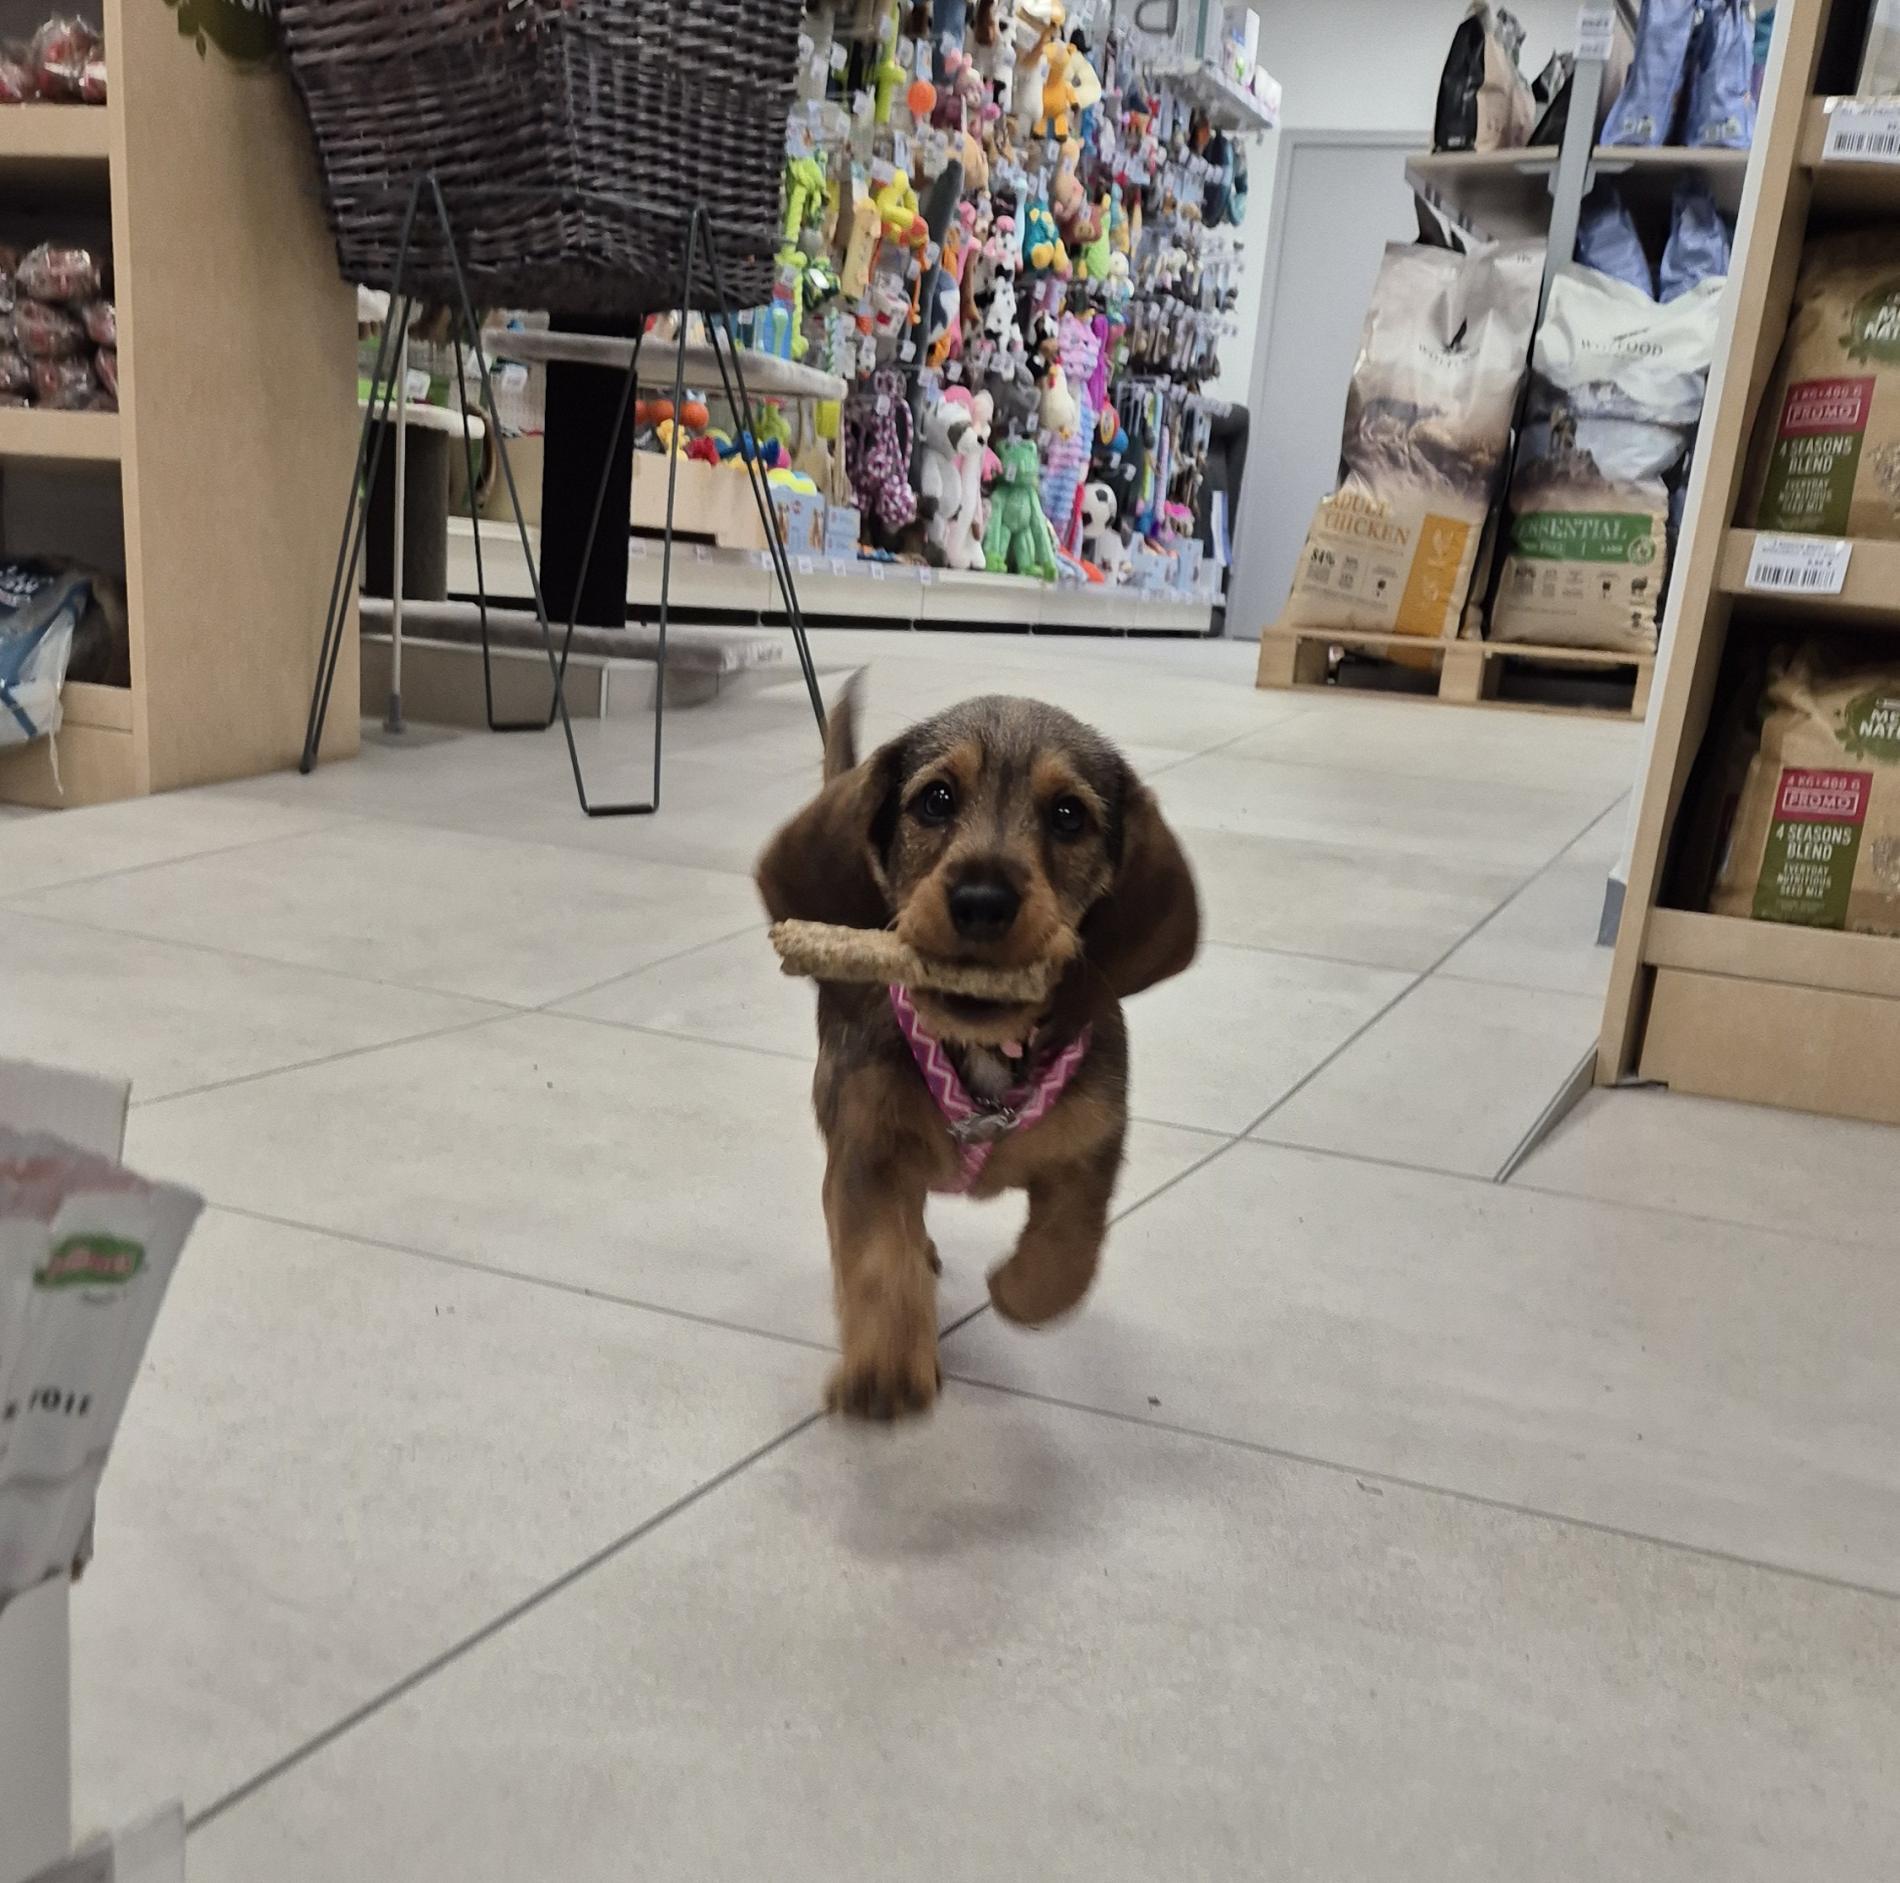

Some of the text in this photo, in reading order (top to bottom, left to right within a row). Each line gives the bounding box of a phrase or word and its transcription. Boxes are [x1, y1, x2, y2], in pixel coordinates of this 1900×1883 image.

[1793, 404, 1852, 421] PROMO
[1789, 436, 1854, 456] SEASONS
[1788, 454, 1834, 474] BLEND
[1324, 512, 1411, 545] CHICKEN
[1518, 517, 1628, 541] ESSENTIAL
[1788, 791, 1851, 809] PROMO
[1776, 824, 1852, 846] 4 SEASONS
[1787, 841, 1833, 862] BLEND
[1783, 862, 1830, 875] EVERYDAY
